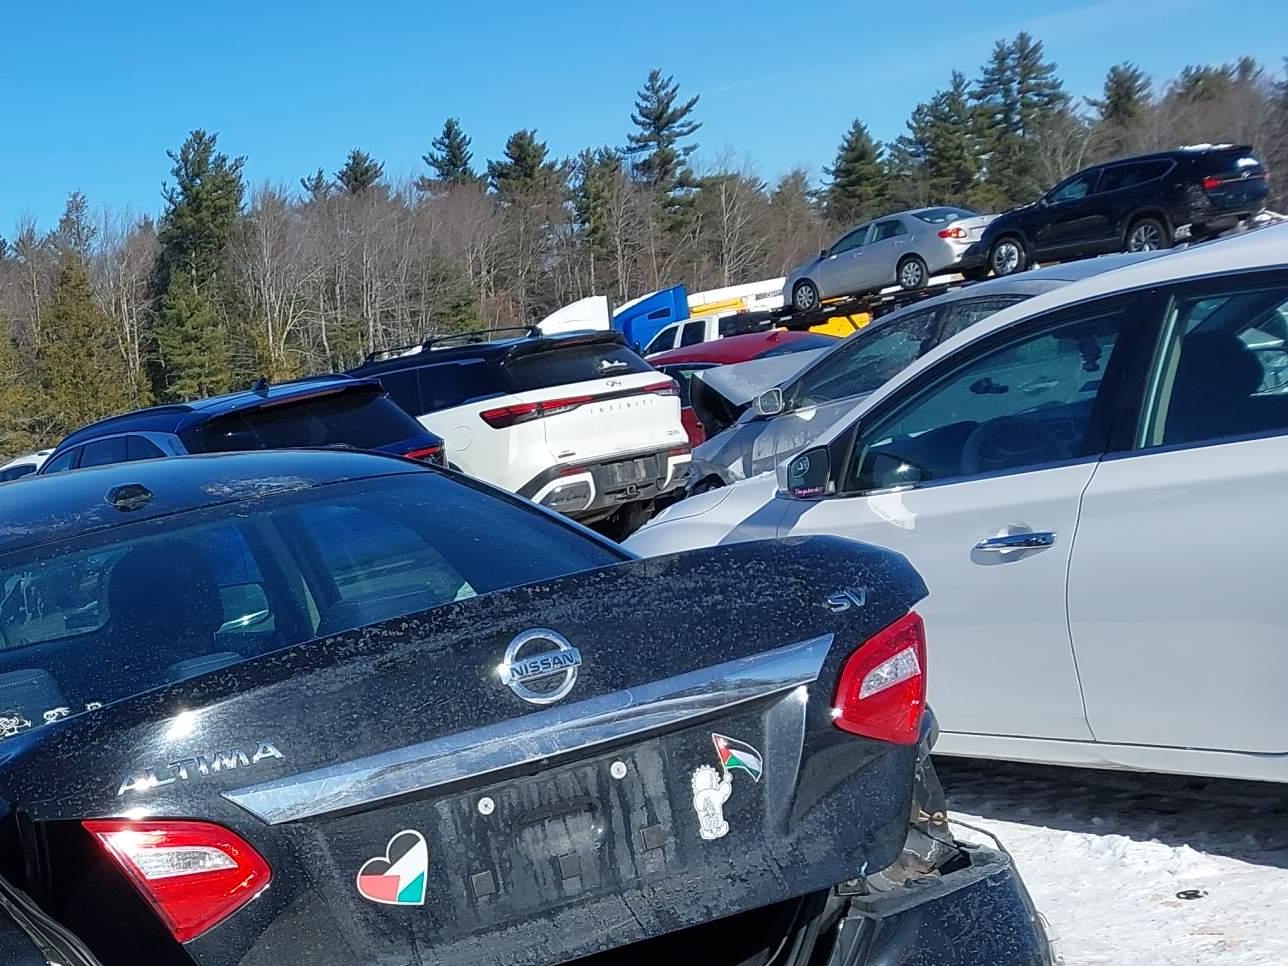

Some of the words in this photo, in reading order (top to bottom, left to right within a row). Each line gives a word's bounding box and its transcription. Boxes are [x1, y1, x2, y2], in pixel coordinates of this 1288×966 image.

[827, 588, 866, 613] SV
[510, 652, 575, 678] NISSAN
[117, 740, 285, 796] ALTIMA
